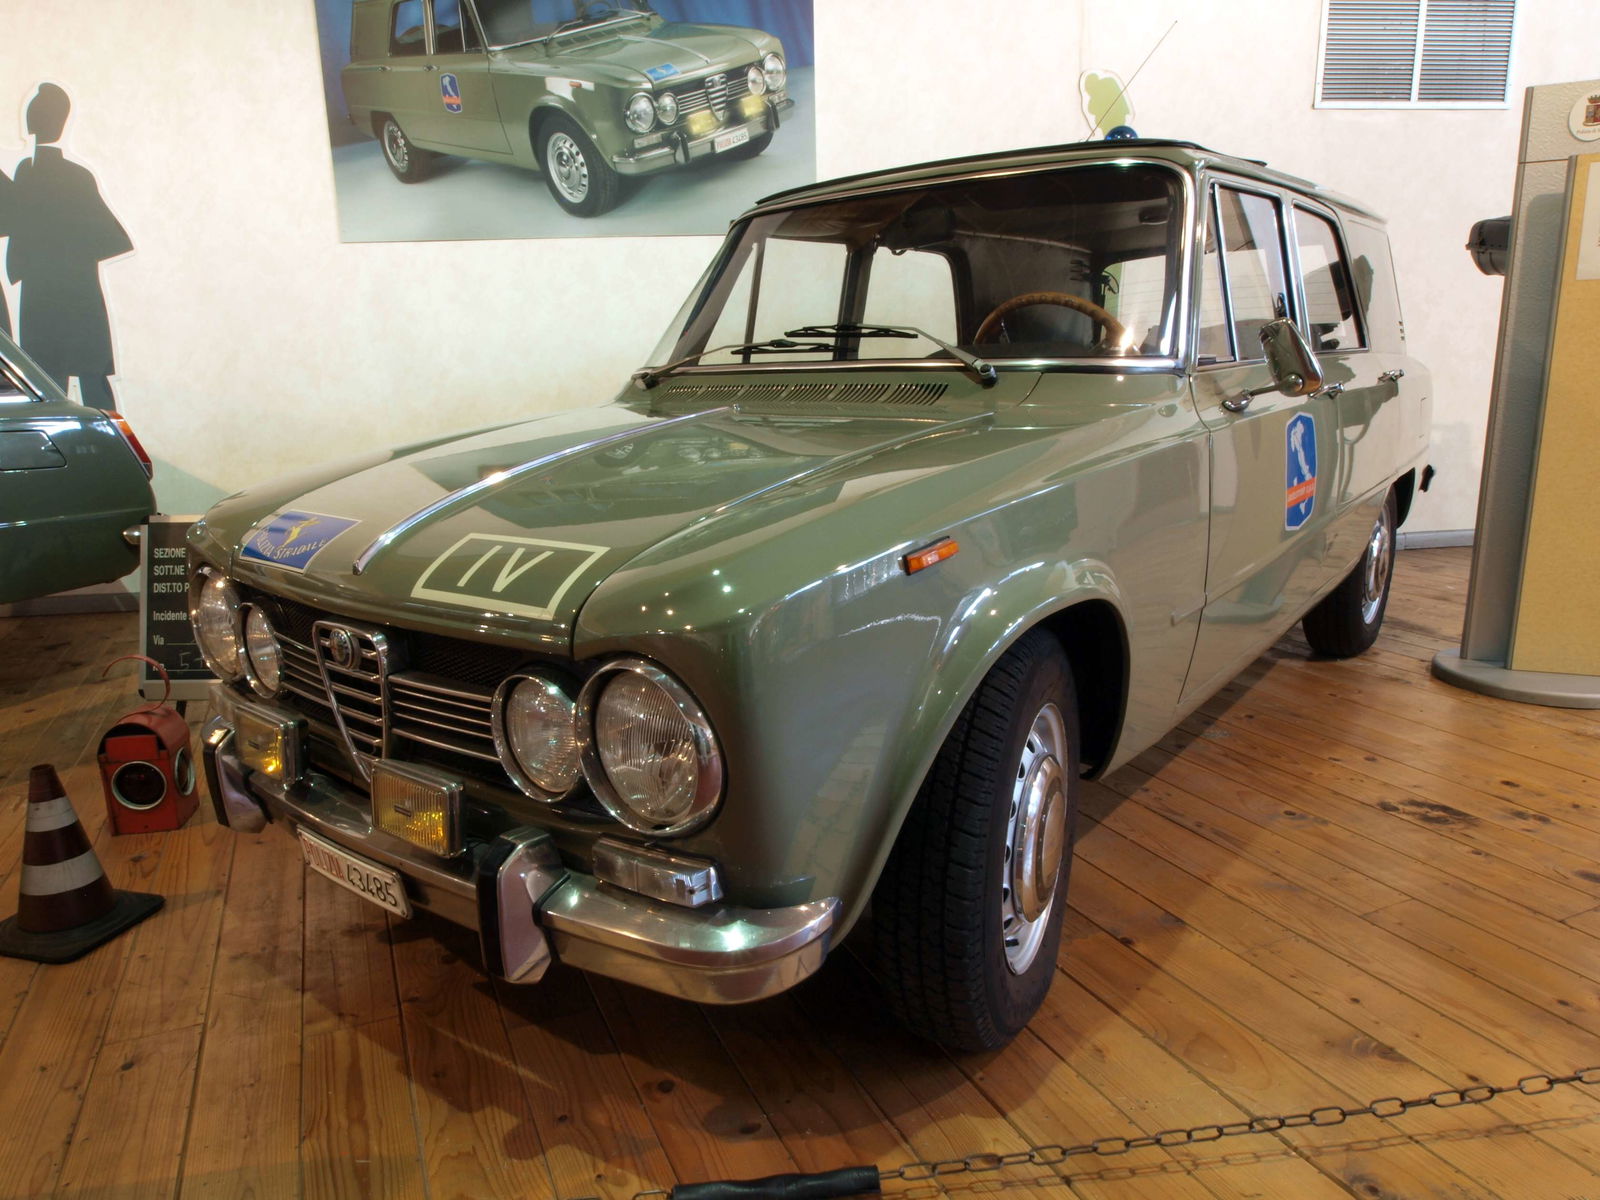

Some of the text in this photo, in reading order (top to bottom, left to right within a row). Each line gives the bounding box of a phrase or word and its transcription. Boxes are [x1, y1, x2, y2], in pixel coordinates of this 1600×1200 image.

[154, 548, 186, 558] SEZIONE
[153, 565, 185, 576] SOTT.NE
[457, 545, 554, 592] IV
[153, 582, 183, 593] DIST.TO
[153, 611, 187, 621] Incidente
[153, 635, 165, 646] Via
[346, 864, 397, 907] 43485
